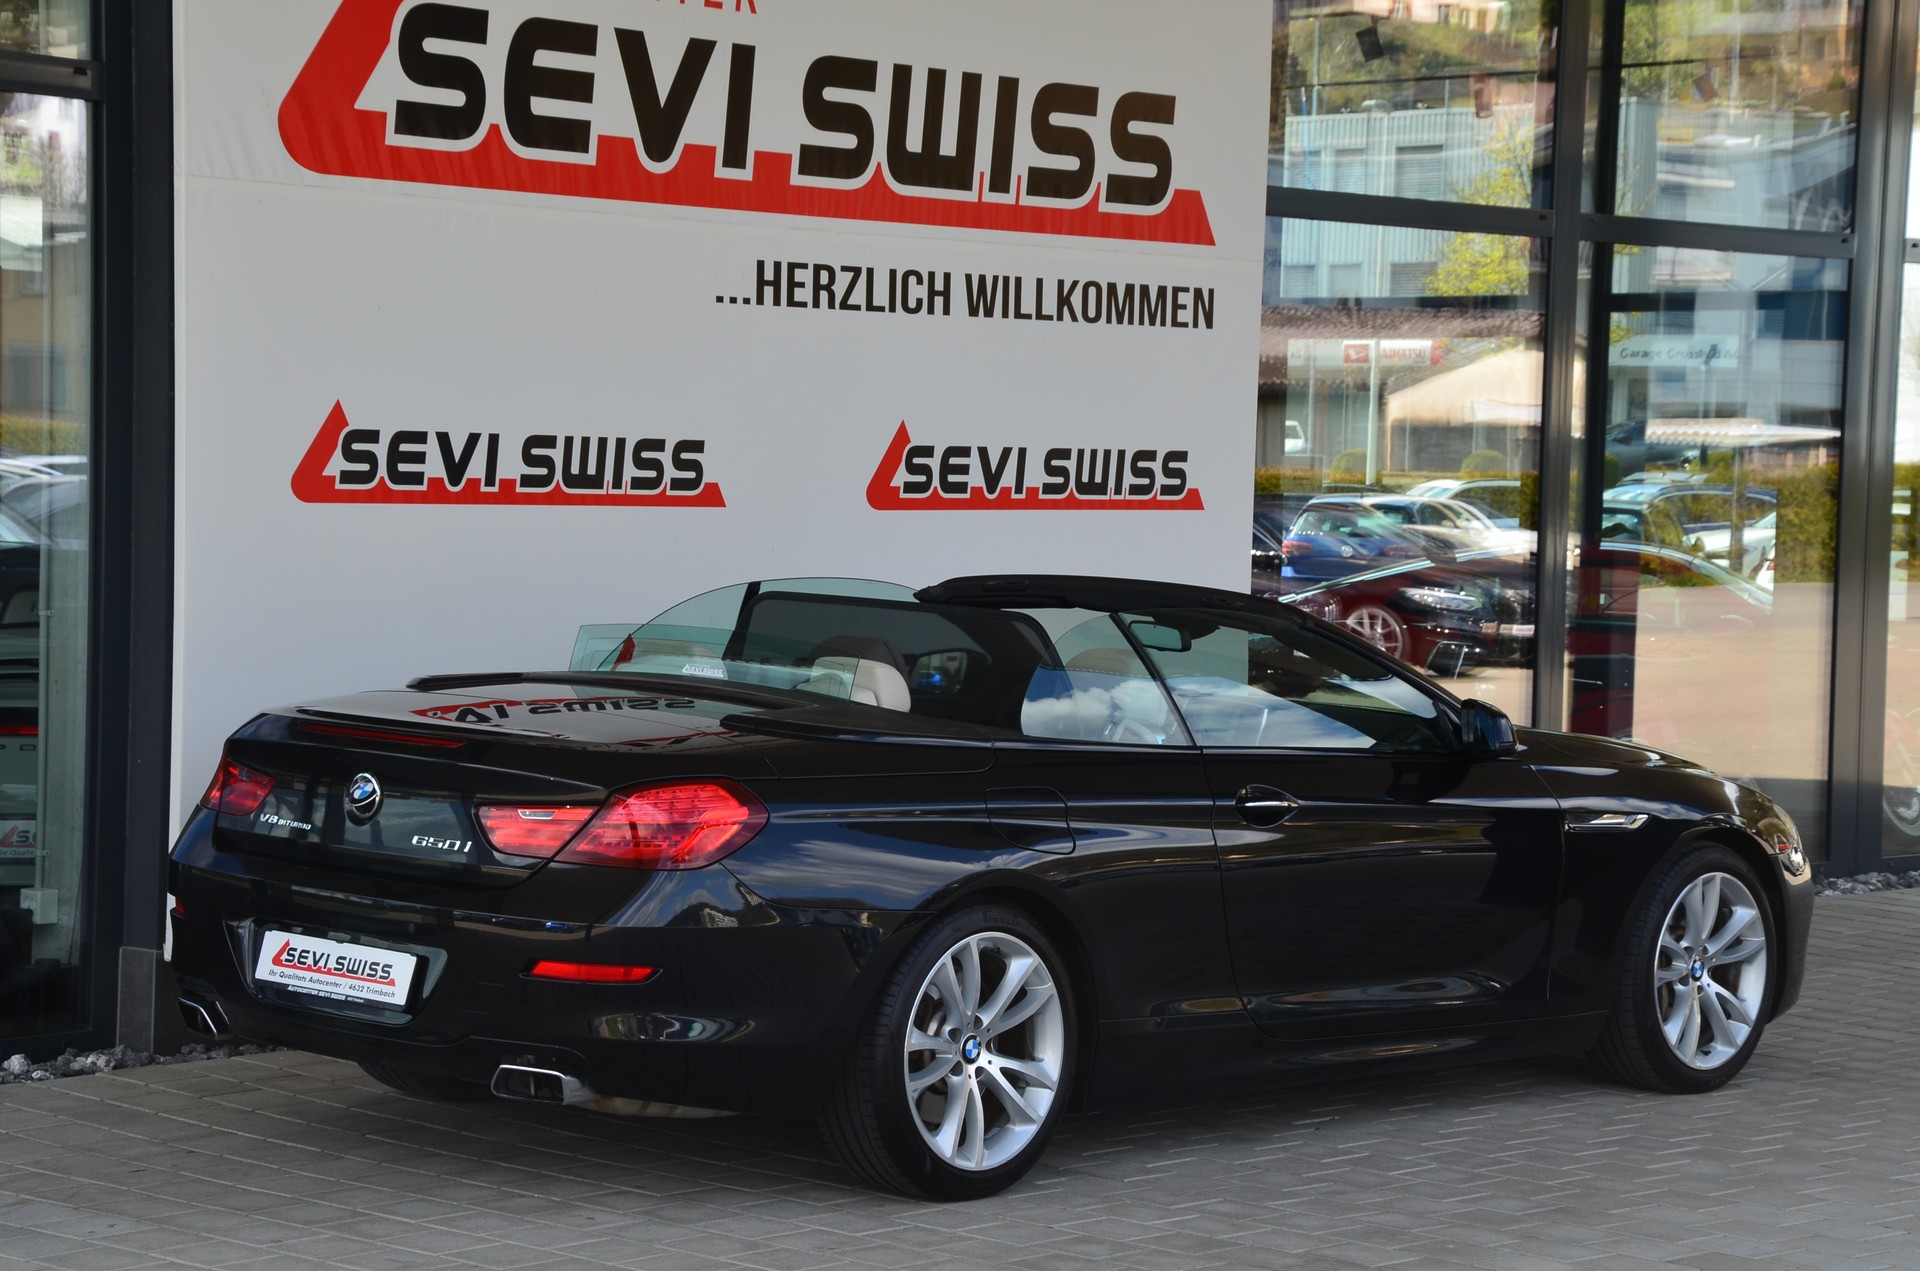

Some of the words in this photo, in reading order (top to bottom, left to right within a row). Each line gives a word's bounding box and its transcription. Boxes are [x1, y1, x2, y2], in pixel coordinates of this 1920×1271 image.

[394, 3, 755, 170] SEVI
[798, 56, 1176, 207] SWISS
[965, 274, 1215, 330] WILLKOMMEN
[1380, 347, 1426, 360] AIHATSU
[339, 429, 499, 487] SEVI
[520, 435, 705, 492] SWISS
[903, 446, 1027, 496] SEVI
[1042, 448, 1189, 497] SWISS
[260, 813, 279, 824] V8
[268, 968, 278, 977] Ihr
[308, 976, 343, 989] Autocenter
[348, 984, 365, 993] 4632
[365, 986, 396, 999] Trimbach
[284, 947, 330, 970] SEVI
[333, 955, 393, 981] SWISS
